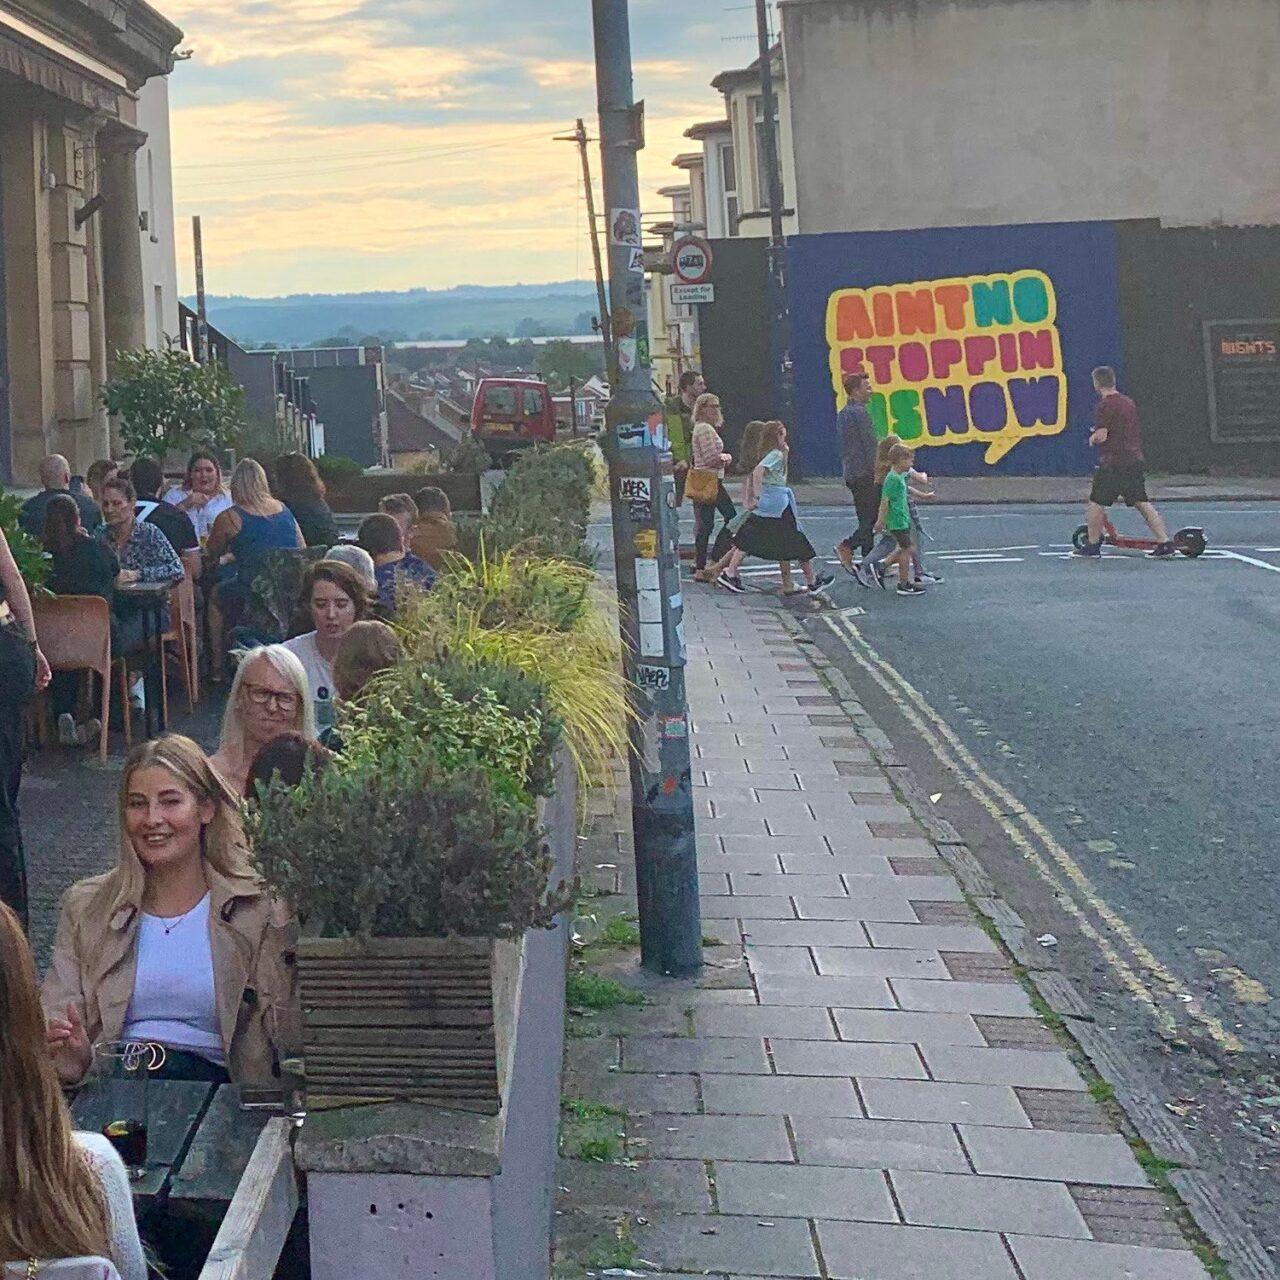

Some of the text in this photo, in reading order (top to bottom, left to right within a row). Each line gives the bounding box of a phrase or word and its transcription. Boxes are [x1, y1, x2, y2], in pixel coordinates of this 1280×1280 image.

[836, 276, 1049, 342] AINT NO
[839, 329, 1054, 385] STOPPIN
[868, 375, 1060, 440] IS NOW
